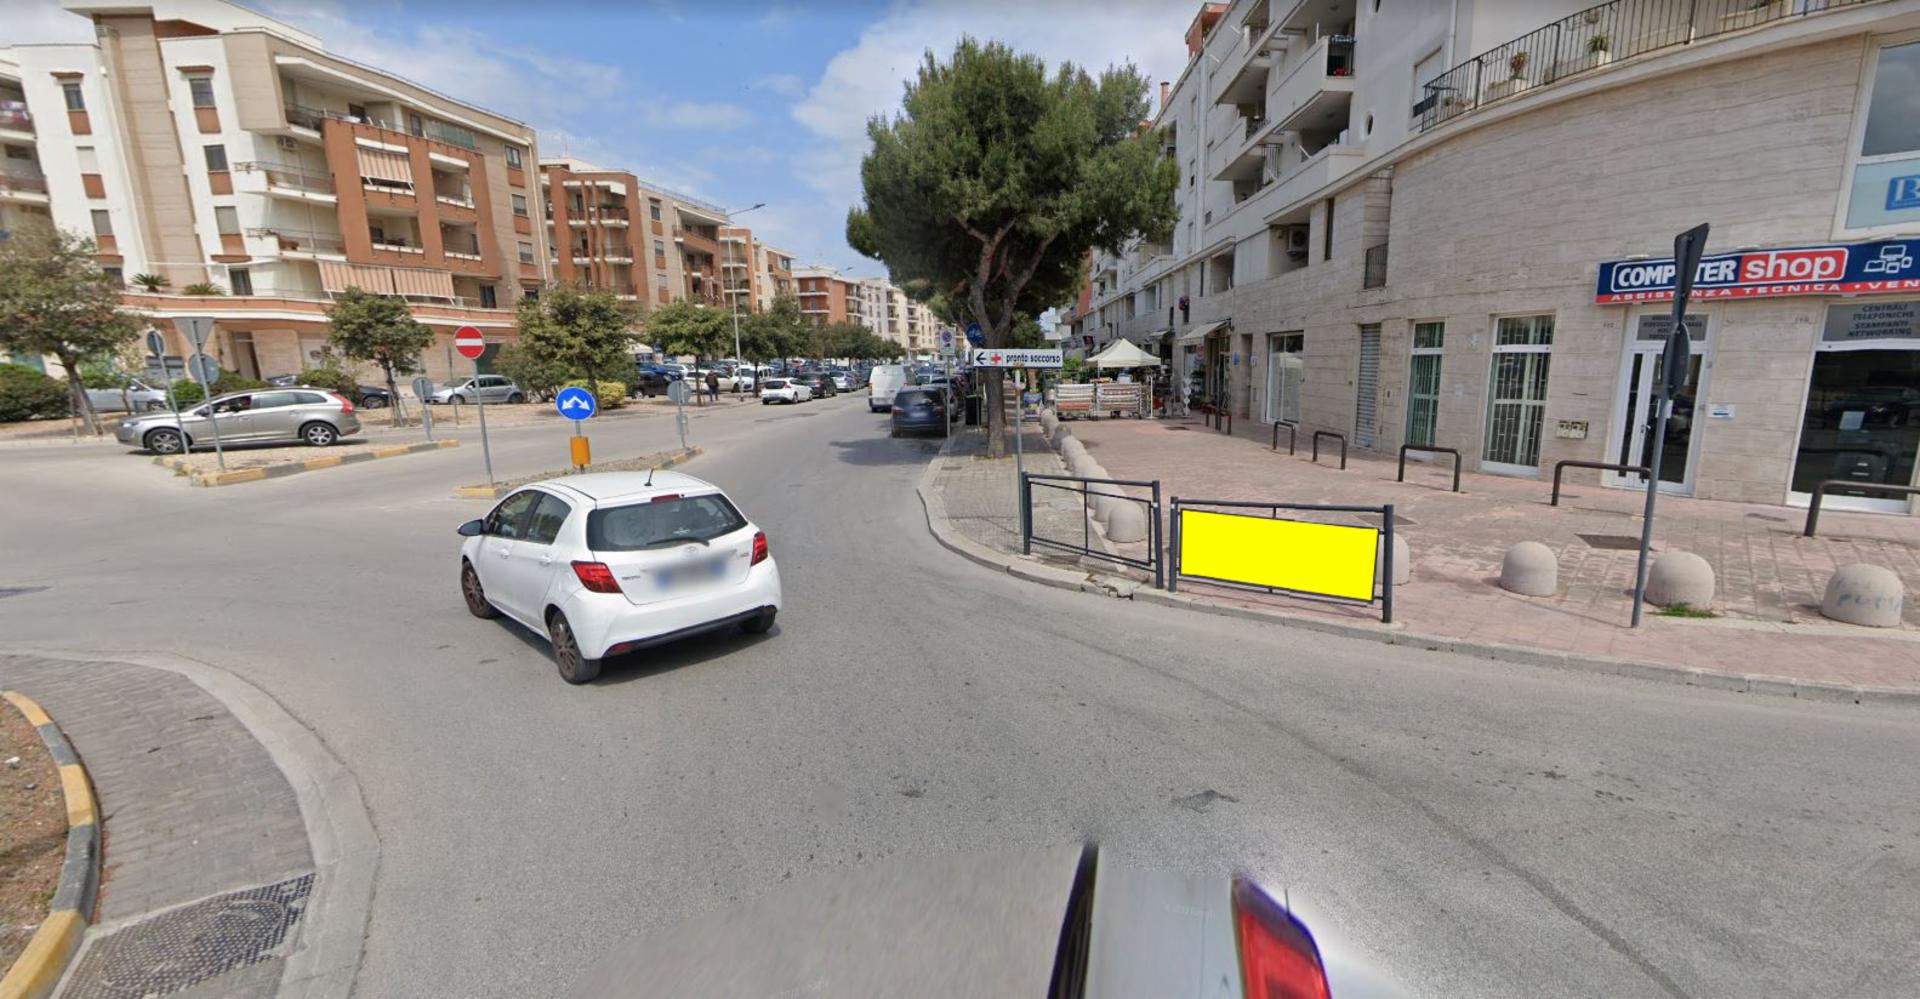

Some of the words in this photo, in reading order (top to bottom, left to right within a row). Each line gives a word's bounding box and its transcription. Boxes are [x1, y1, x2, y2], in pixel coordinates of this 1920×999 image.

[1618, 260, 1737, 287] COMPTER
[1746, 253, 1836, 280] shop
[1611, 288, 1732, 301] ASSISTNZA
[1744, 284, 1840, 294] TECNICA
[1006, 353, 1028, 363] pronto
[1030, 354, 1060, 363] soccorso
